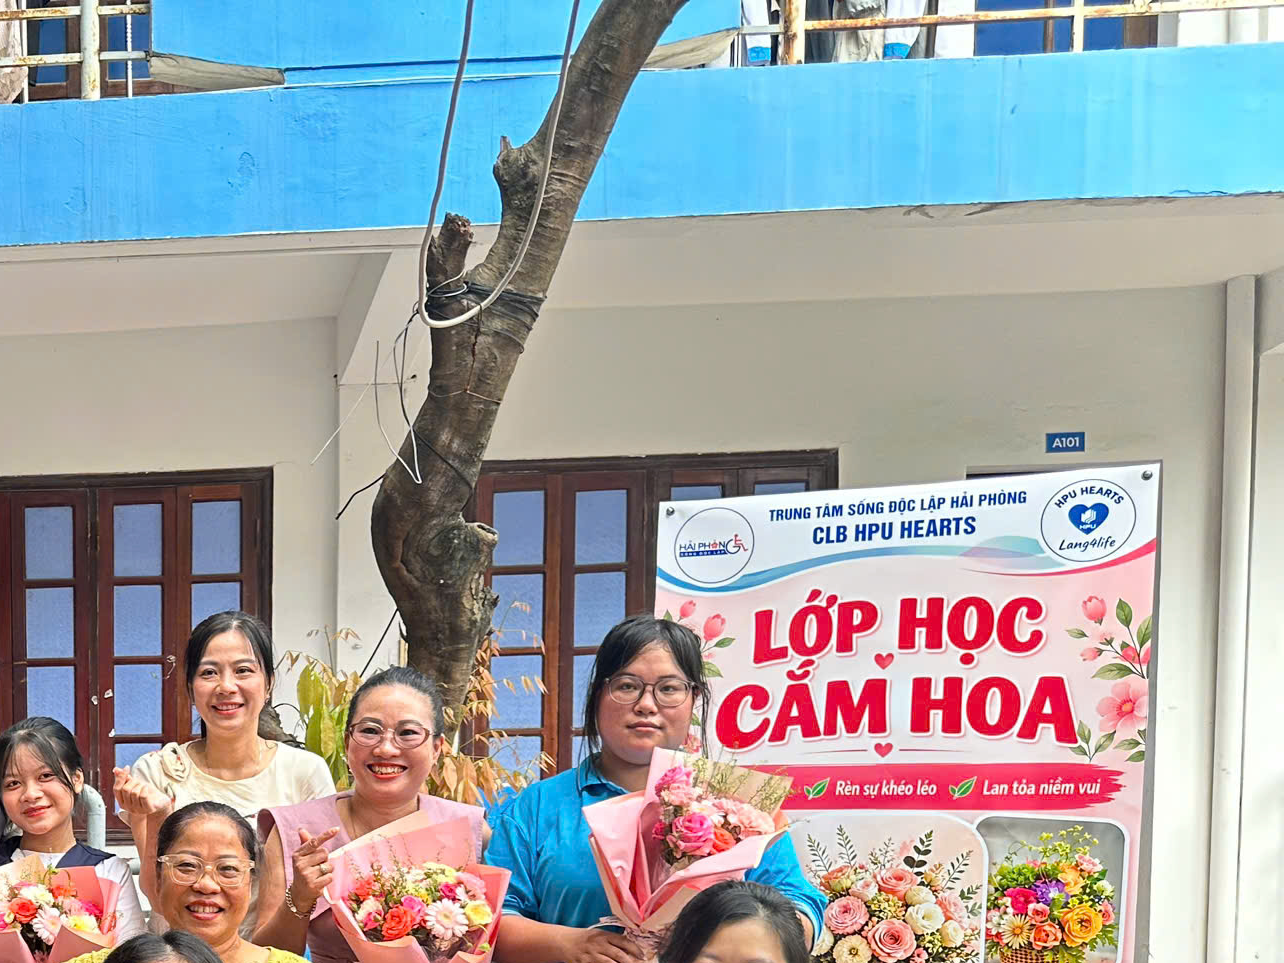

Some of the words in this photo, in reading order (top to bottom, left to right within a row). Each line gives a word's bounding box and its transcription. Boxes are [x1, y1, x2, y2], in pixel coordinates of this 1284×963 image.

[1052, 437, 1080, 448] A101
[769, 507, 811, 522] TRUNG
[816, 503, 843, 518] TÂM
[848, 498, 884, 516] SỐNG
[889, 498, 916, 516] ĐỘC
[920, 495, 946, 514] LẬP
[950, 491, 974, 508] HẢI
[978, 489, 1027, 507] PHÒNG
[1054, 490, 1077, 508] HPU
[1080, 486, 1124, 504] HEARTS
[812, 525, 847, 545] CLB
[854, 521, 893, 542] HPU
[900, 516, 976, 539] HEARTS
[1059, 536, 1116, 552] Lang4life
[752, 588, 879, 664] LỚP
[897, 596, 1043, 666] HỌC
[716, 661, 888, 751] CẮM
[909, 676, 1079, 744] HOA
[836, 780, 860, 796] Rèn
[863, 782, 880, 800] sự
[881, 779, 914, 796] khéo
[917, 780, 938, 796] léo
[983, 780, 1008, 796] Lan
[1012, 778, 1036, 796] tỏa
[1039, 776, 1075, 796] niềm
[1078, 779, 1100, 794] vui
